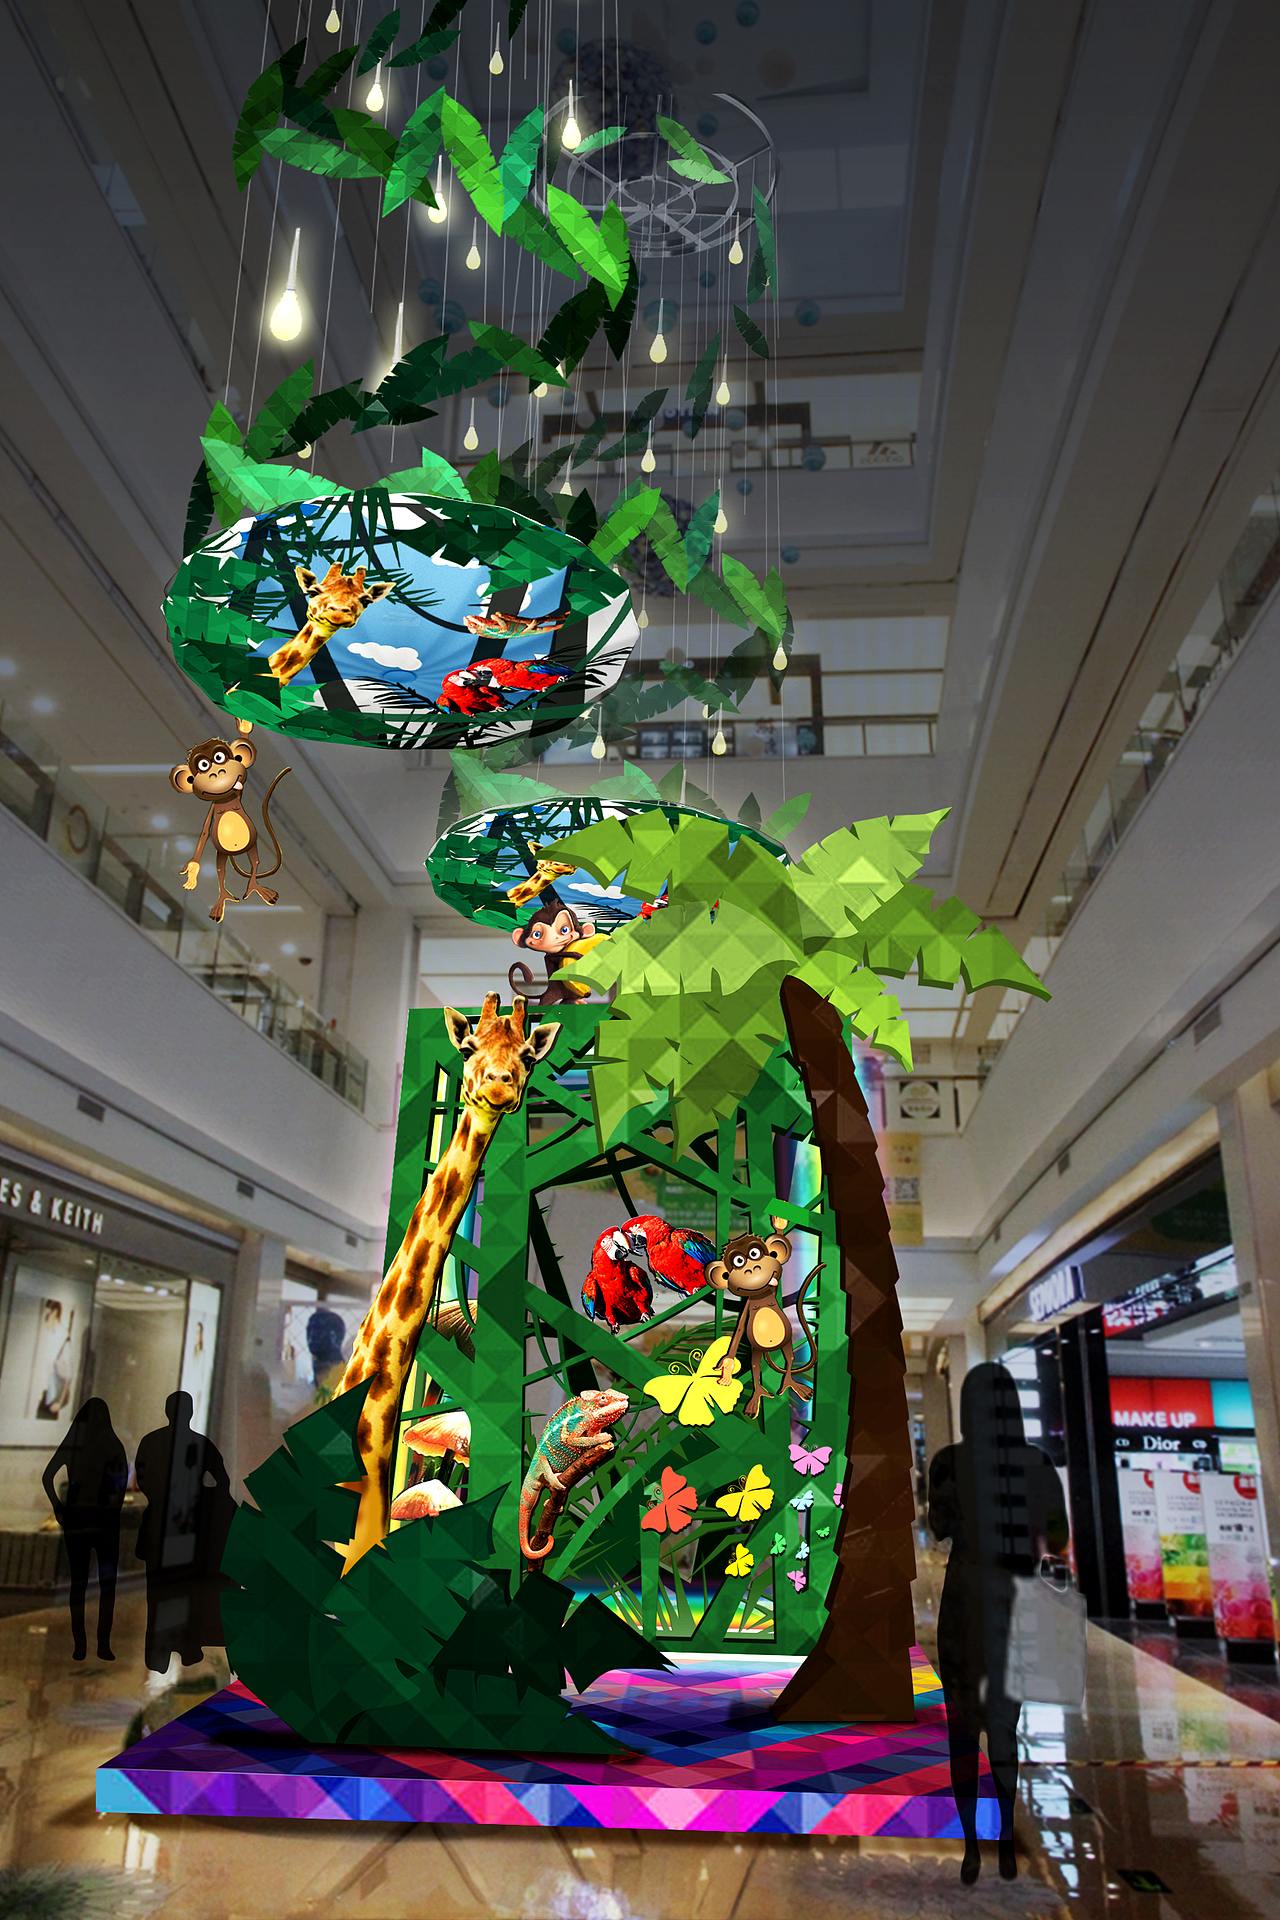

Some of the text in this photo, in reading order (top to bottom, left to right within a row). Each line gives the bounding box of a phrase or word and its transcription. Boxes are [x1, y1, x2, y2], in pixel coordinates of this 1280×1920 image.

[30, 1190, 42, 1214] &
[51, 1198, 103, 1234] KEITH
[1113, 1410, 1197, 1429] MAKE UP
[1142, 1434, 1182, 1451] Dior
